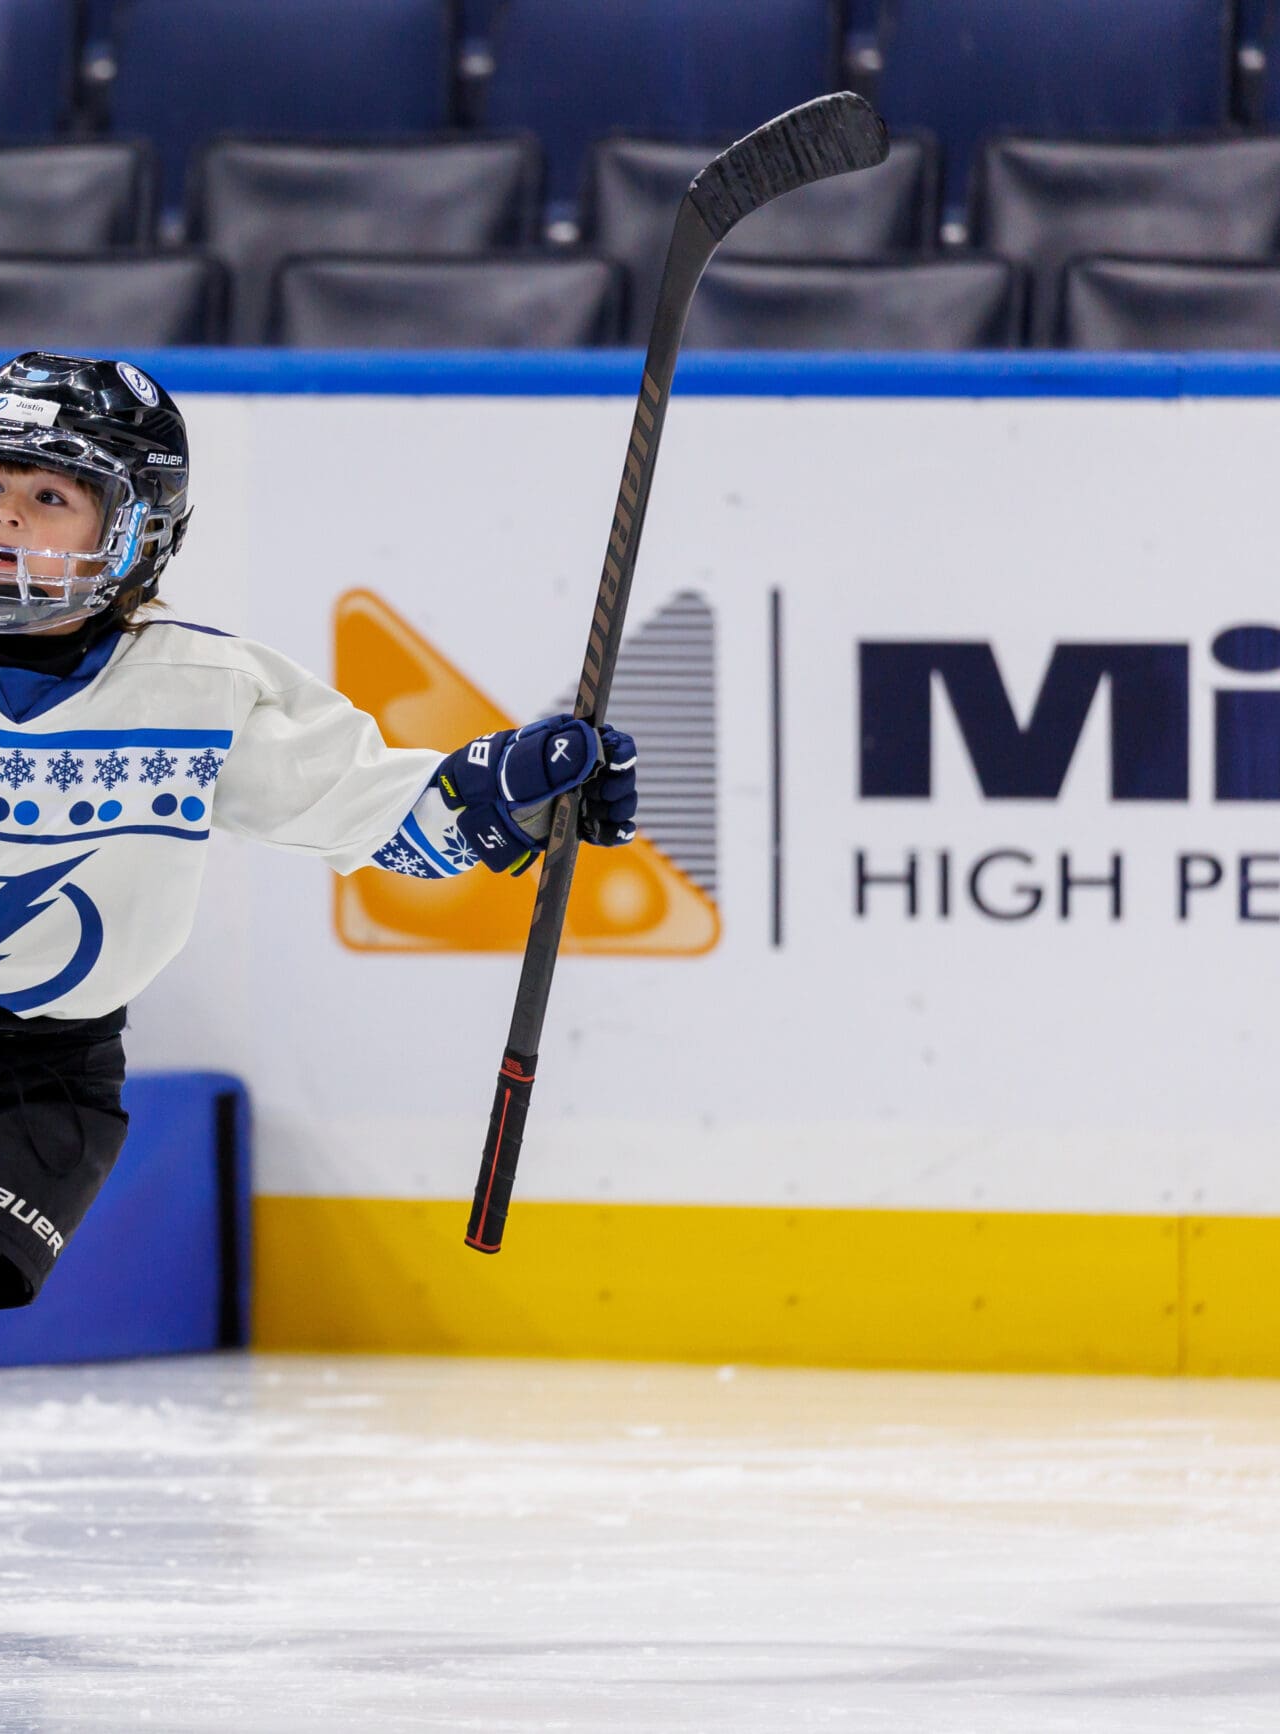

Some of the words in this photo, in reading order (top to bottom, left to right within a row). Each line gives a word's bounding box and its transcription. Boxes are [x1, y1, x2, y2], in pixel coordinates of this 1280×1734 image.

[15, 400, 45, 413] Justin
[856, 624, 1280, 801] Mi
[856, 848, 1124, 921] HIGH
